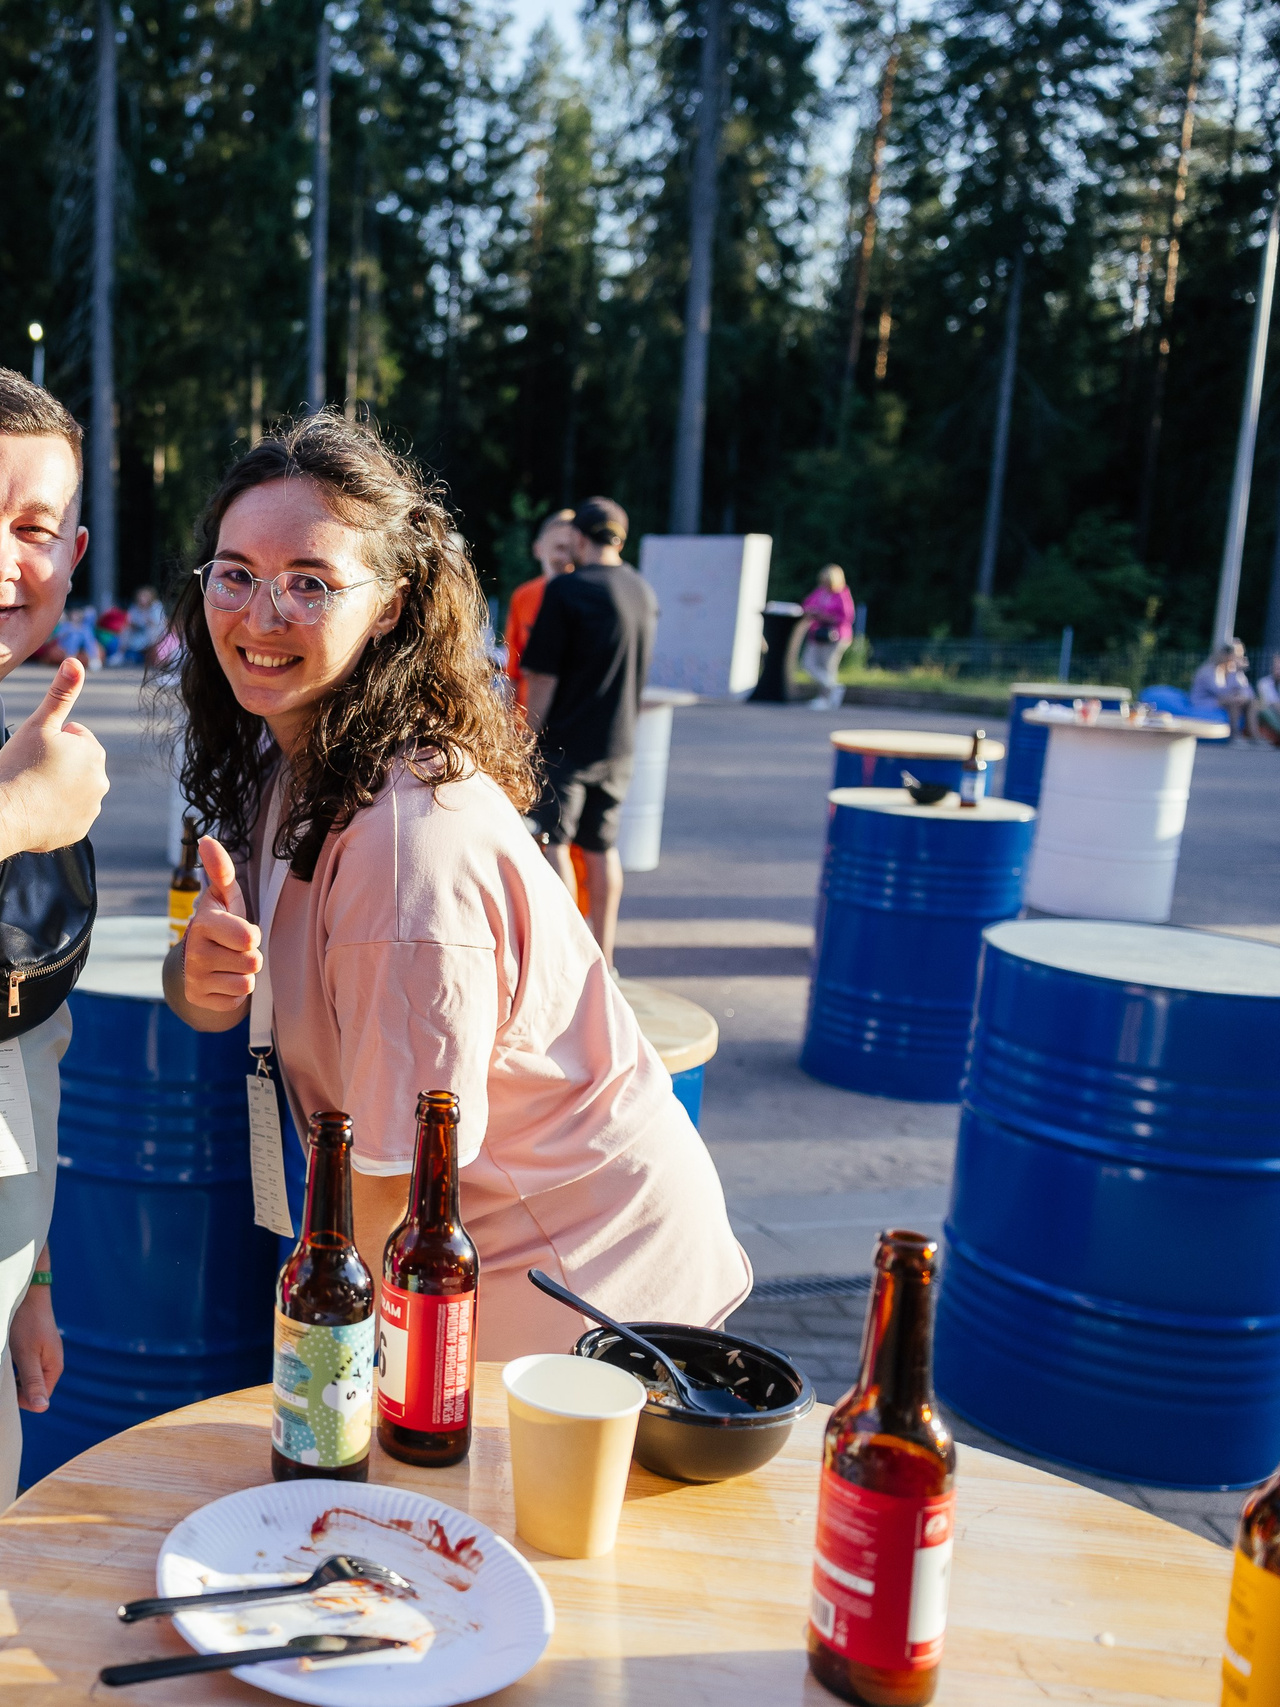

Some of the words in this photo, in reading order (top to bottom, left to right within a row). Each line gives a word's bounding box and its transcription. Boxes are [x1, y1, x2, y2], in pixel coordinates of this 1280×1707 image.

[446, 1302, 460, 1343] АЛКОГОЛЬНОЙ
[458, 1300, 470, 1334] ЗДОРОВЬЮ
[444, 1344, 458, 1387] УПОТРЕБЛЕНИЕ
[457, 1335, 468, 1361] ВАШЕМУ
[456, 1362, 467, 1385] ВРЕДИТ
[442, 1387, 456, 1424] ЧРЕЗМЕРНОЕ
[454, 1385, 466, 1423] ПРОДУКЦИИ
